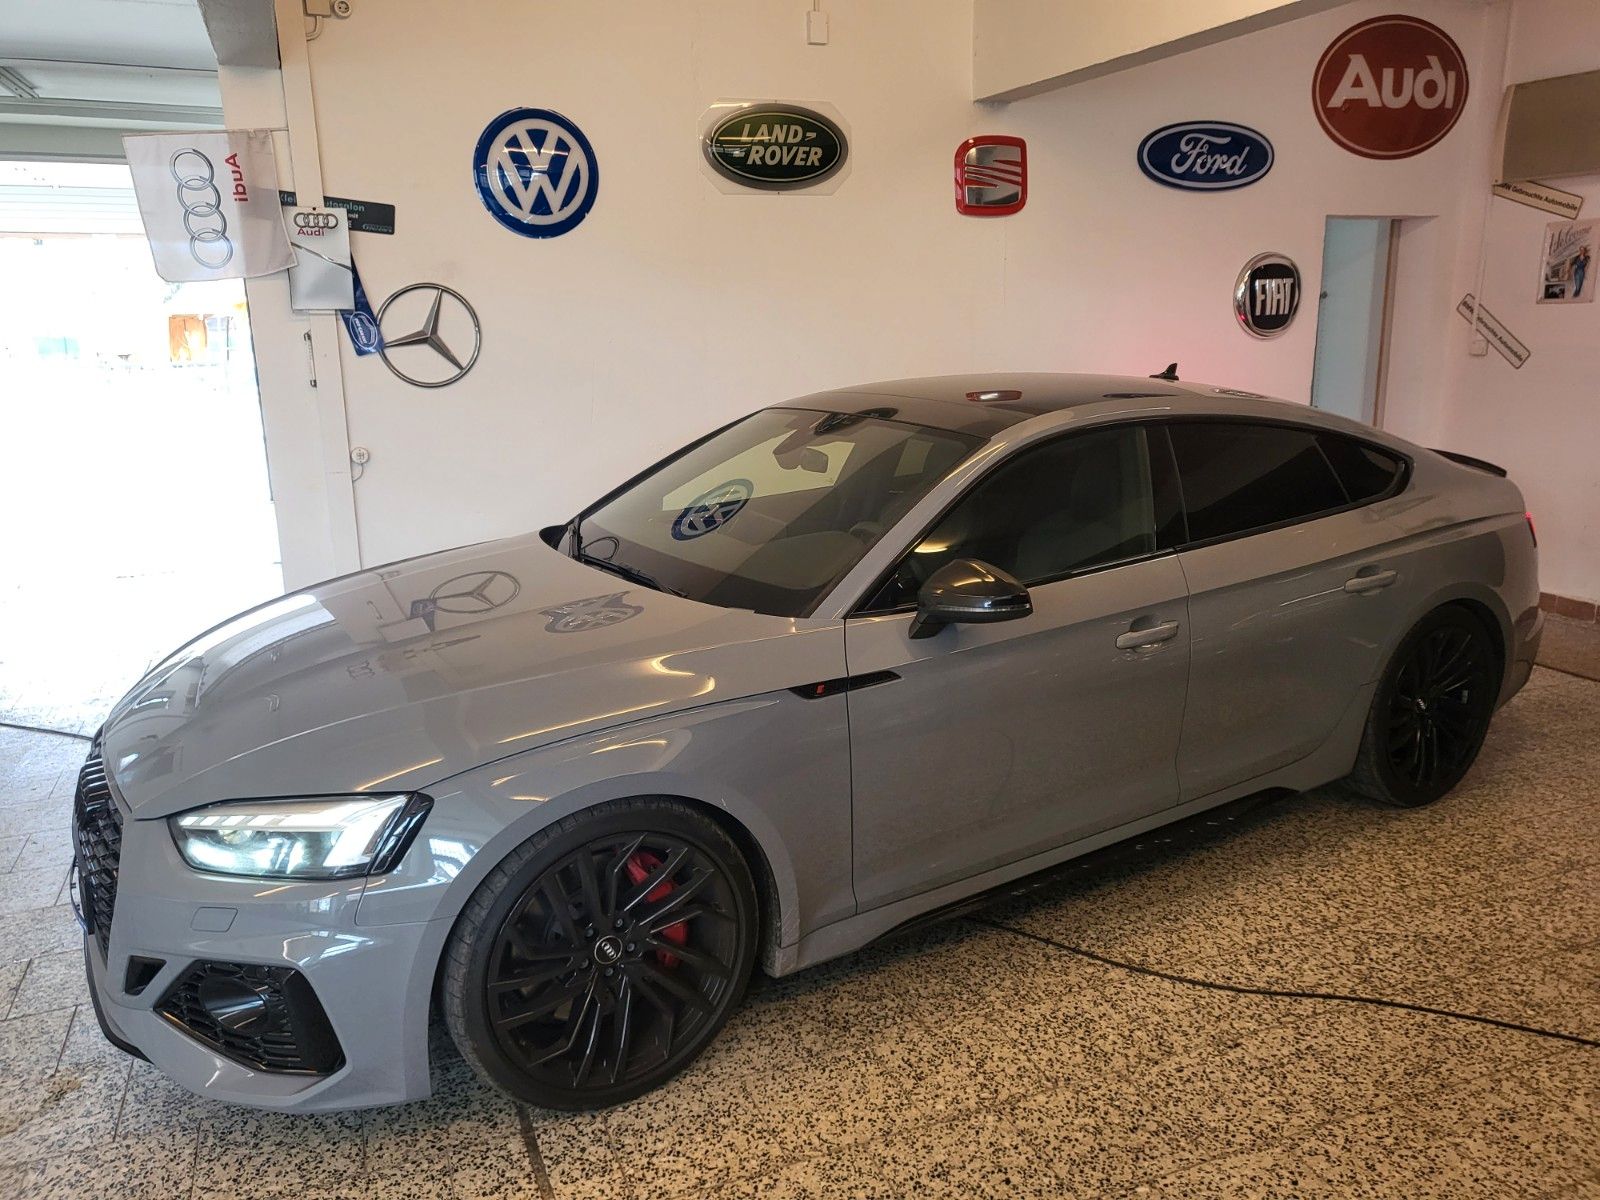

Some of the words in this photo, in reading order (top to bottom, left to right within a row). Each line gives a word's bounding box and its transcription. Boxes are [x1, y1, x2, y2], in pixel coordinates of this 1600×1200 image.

[1327, 53, 1456, 110] Audi
[1170, 132, 1251, 177] Ford
[297, 228, 326, 237] Audi
[1254, 277, 1294, 316] FIAT
